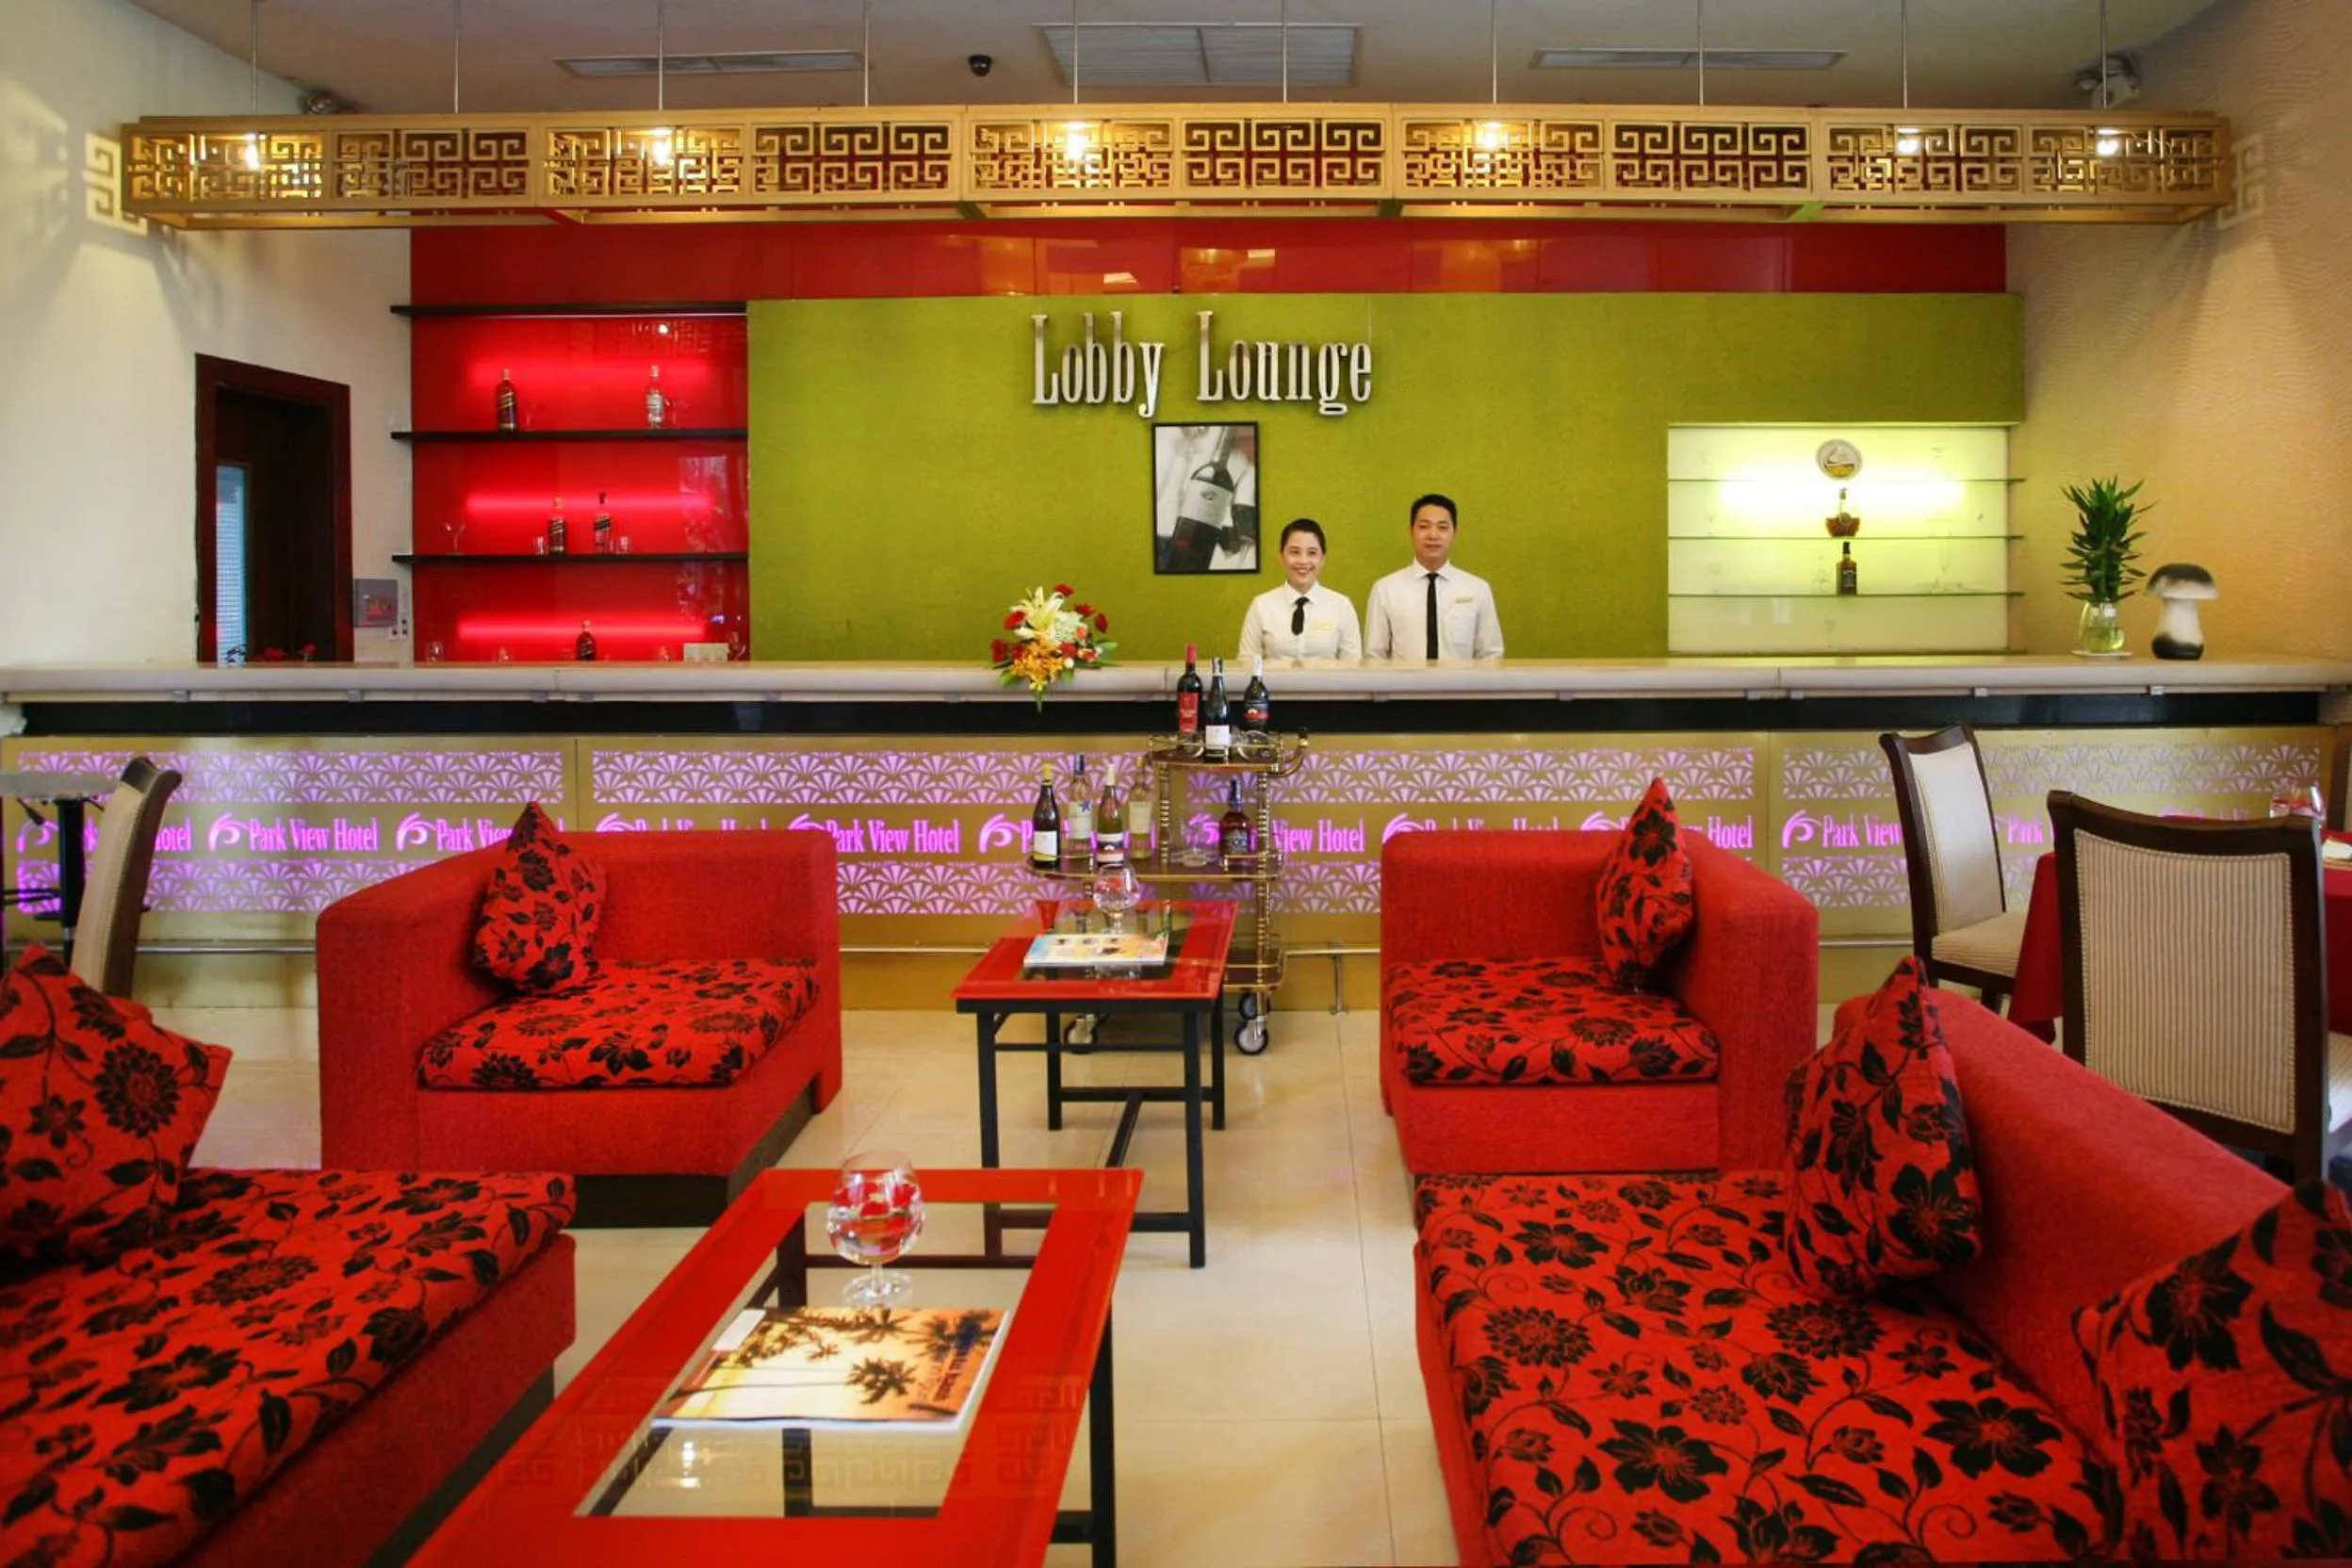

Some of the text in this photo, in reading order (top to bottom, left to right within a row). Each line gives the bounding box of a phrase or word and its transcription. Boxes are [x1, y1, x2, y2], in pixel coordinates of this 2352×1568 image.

[1031, 310, 1373, 418] Lobby Lounge
[155, 816, 193, 852] otel
[249, 816, 378, 852] Park View Hotel
[436, 818, 474, 852] Park
[868, 819, 909, 853] View
[913, 818, 960, 853] Hotel
[1272, 818, 1364, 853] View Hotel
[1707, 815, 1753, 848] Hotel
[1822, 814, 1860, 847] Park
